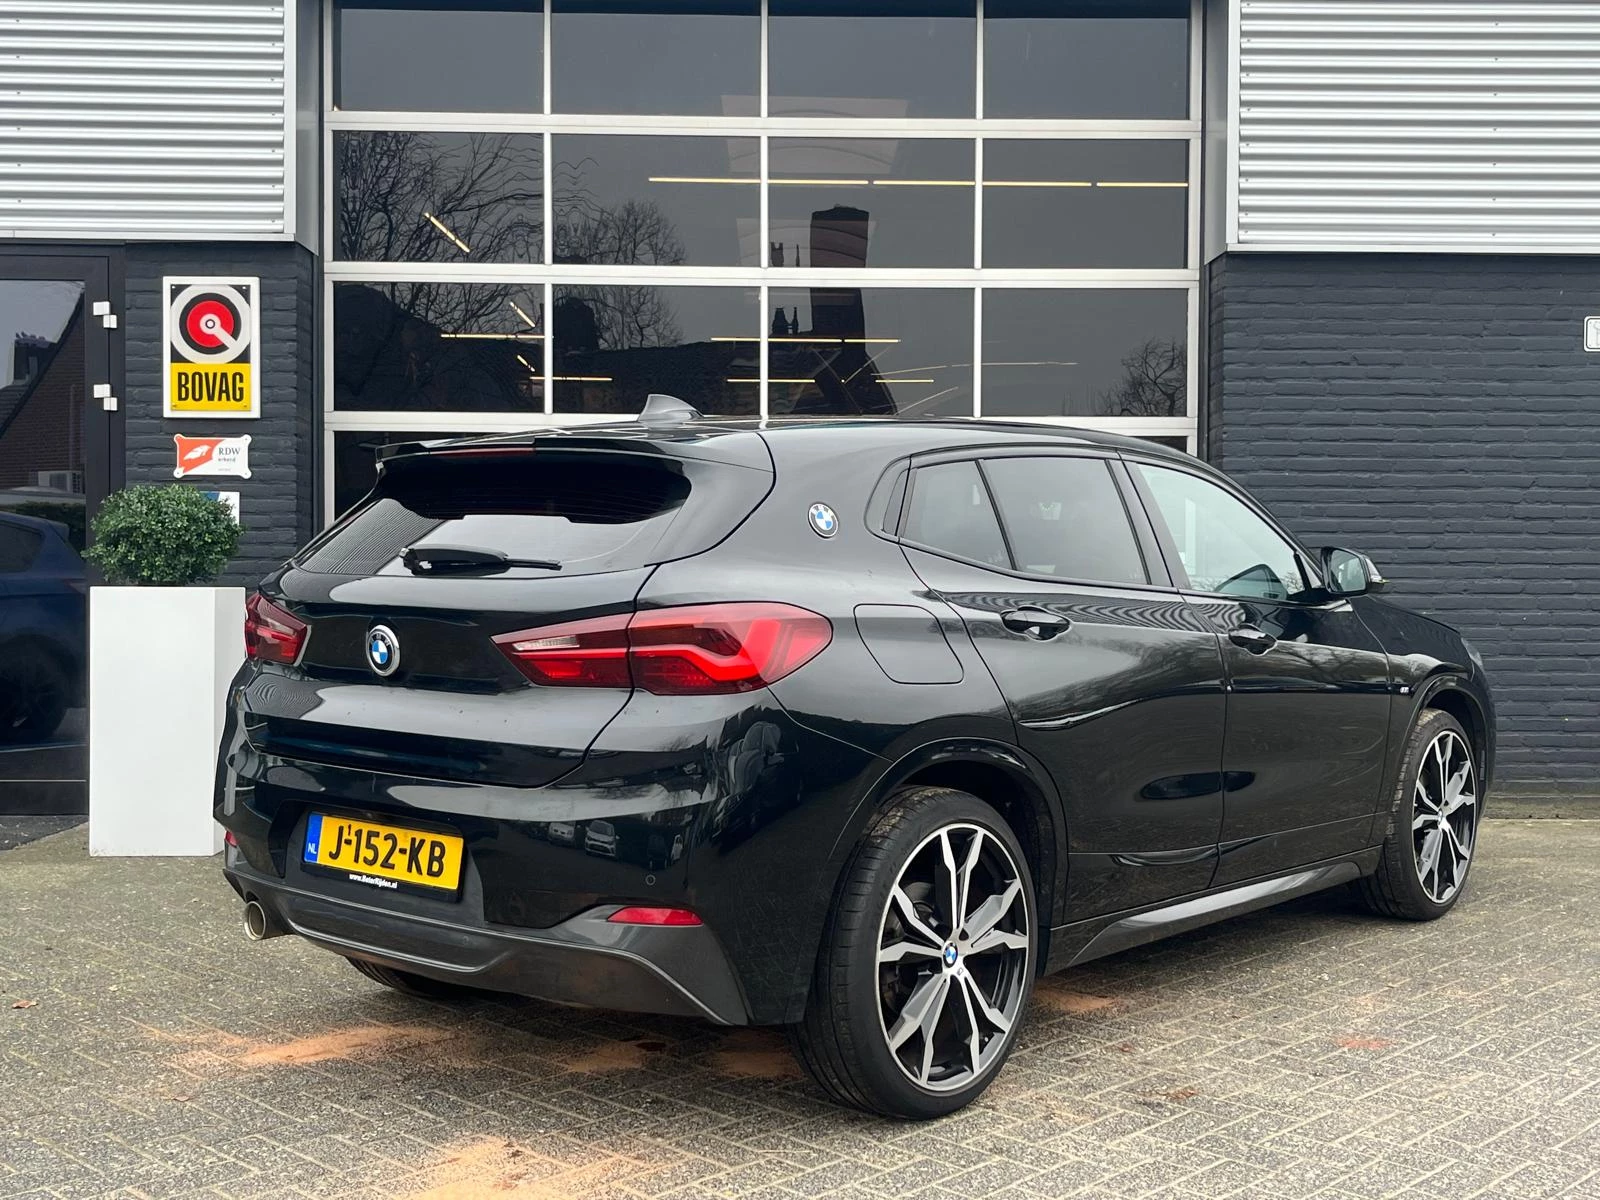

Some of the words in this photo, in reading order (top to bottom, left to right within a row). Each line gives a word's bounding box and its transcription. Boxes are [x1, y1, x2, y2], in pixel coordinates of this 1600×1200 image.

[178, 372, 244, 402] BOVAG
[218, 447, 241, 456] RDW
[307, 842, 317, 855] NL
[328, 825, 446, 878] J-152-KB
